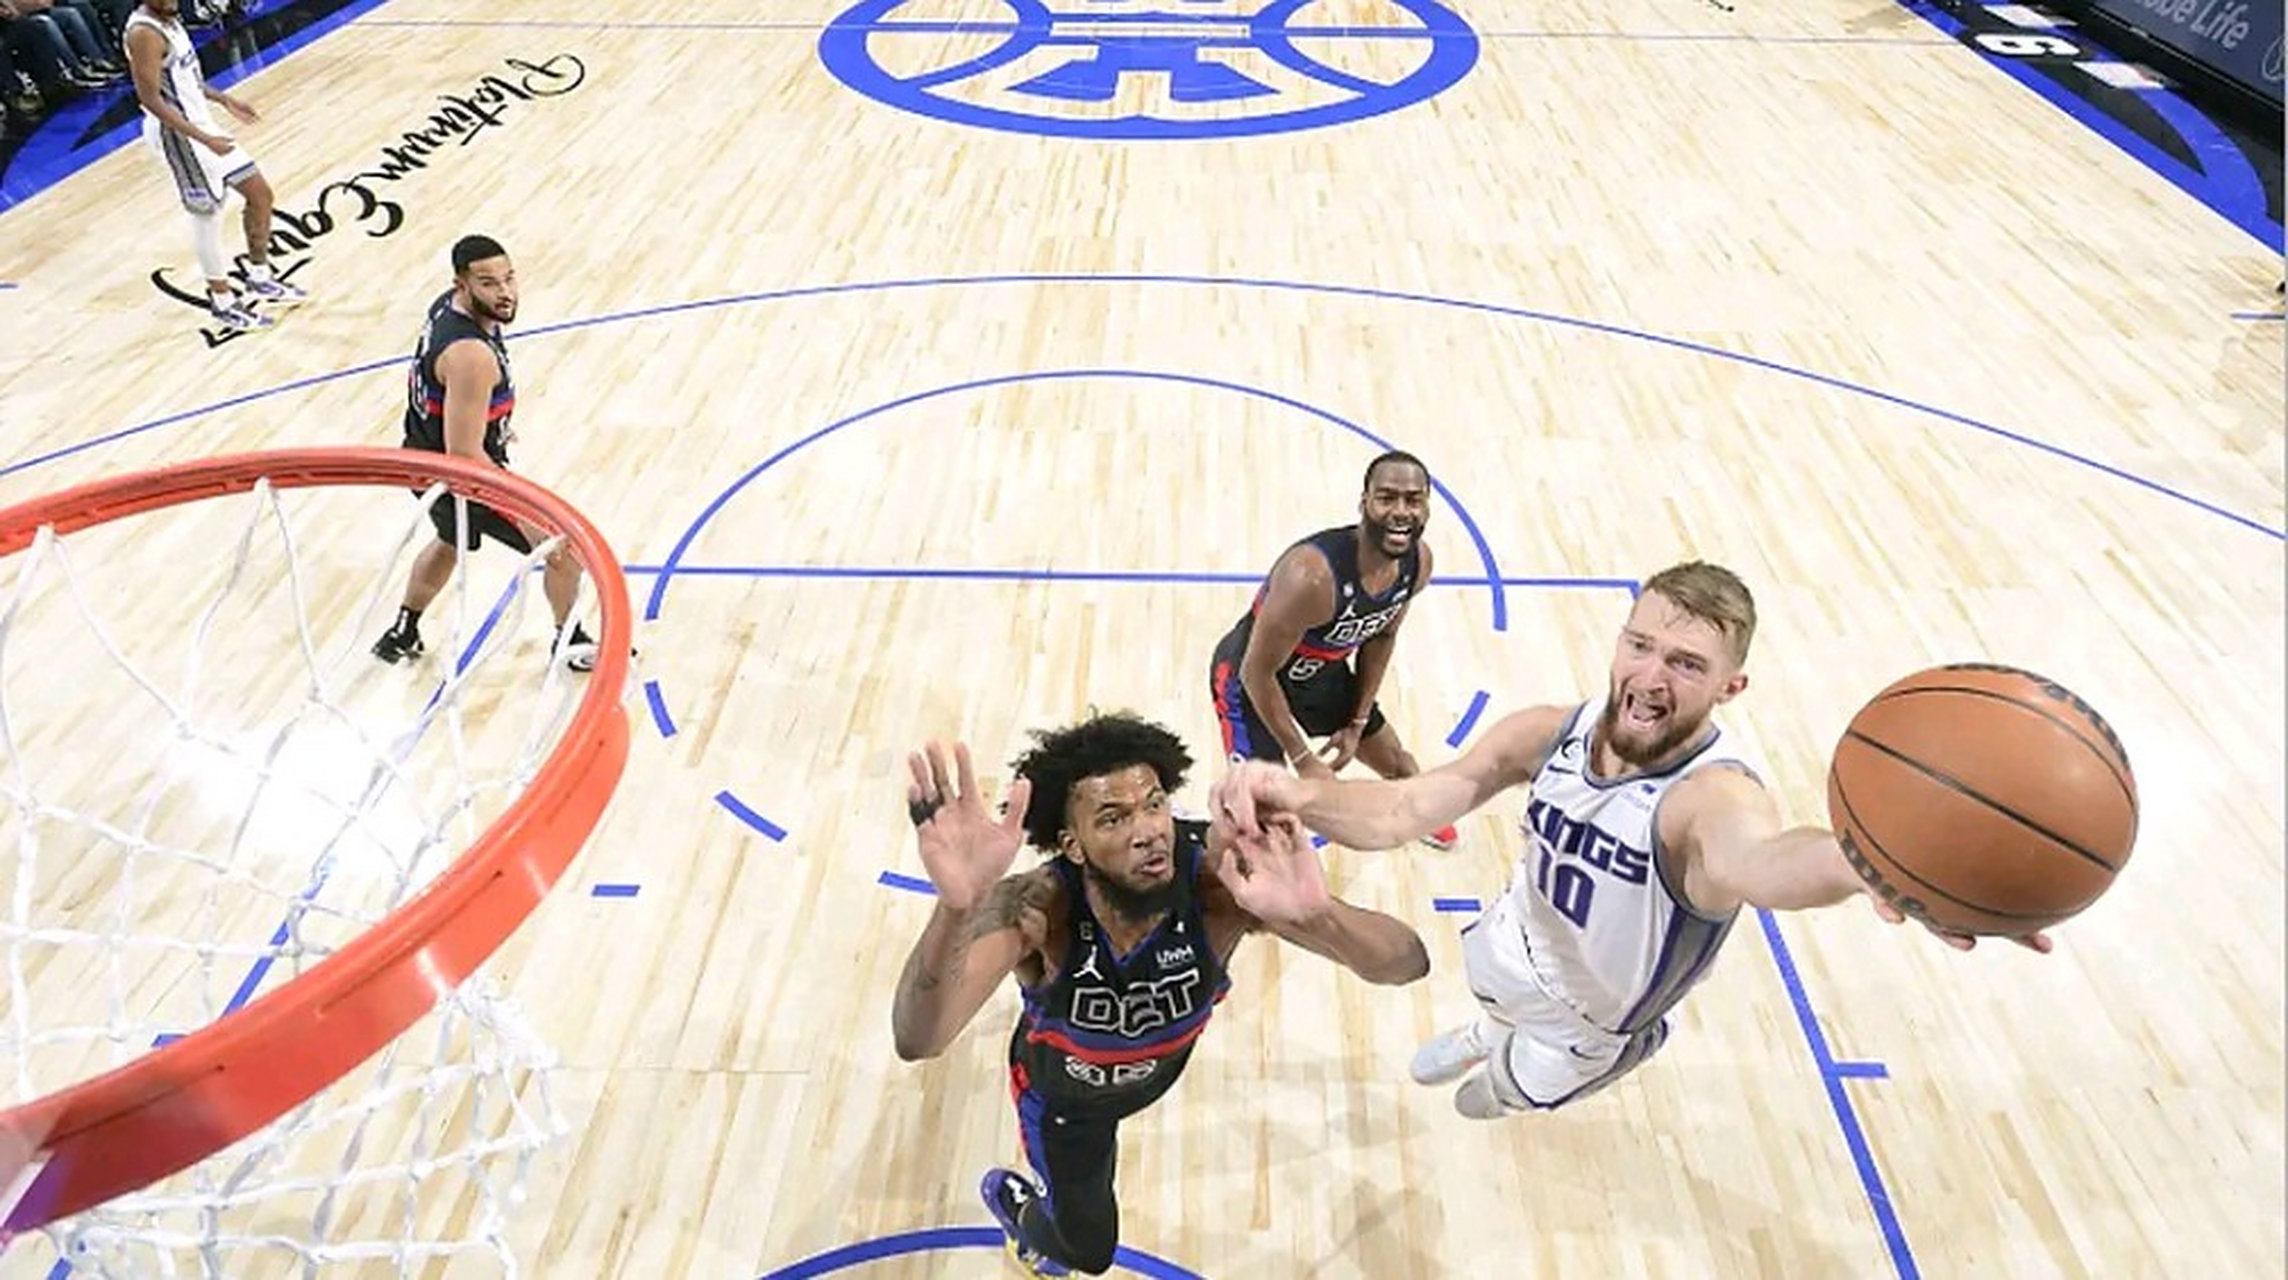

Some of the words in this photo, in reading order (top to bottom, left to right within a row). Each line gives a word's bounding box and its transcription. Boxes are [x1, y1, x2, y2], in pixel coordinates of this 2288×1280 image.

[2190, 0, 2250, 49] Life
[364, 53, 586, 181] Platinum
[1527, 798, 1650, 886] KINGS
[1537, 841, 1596, 929] 10
[1070, 967, 1200, 1037] DET
